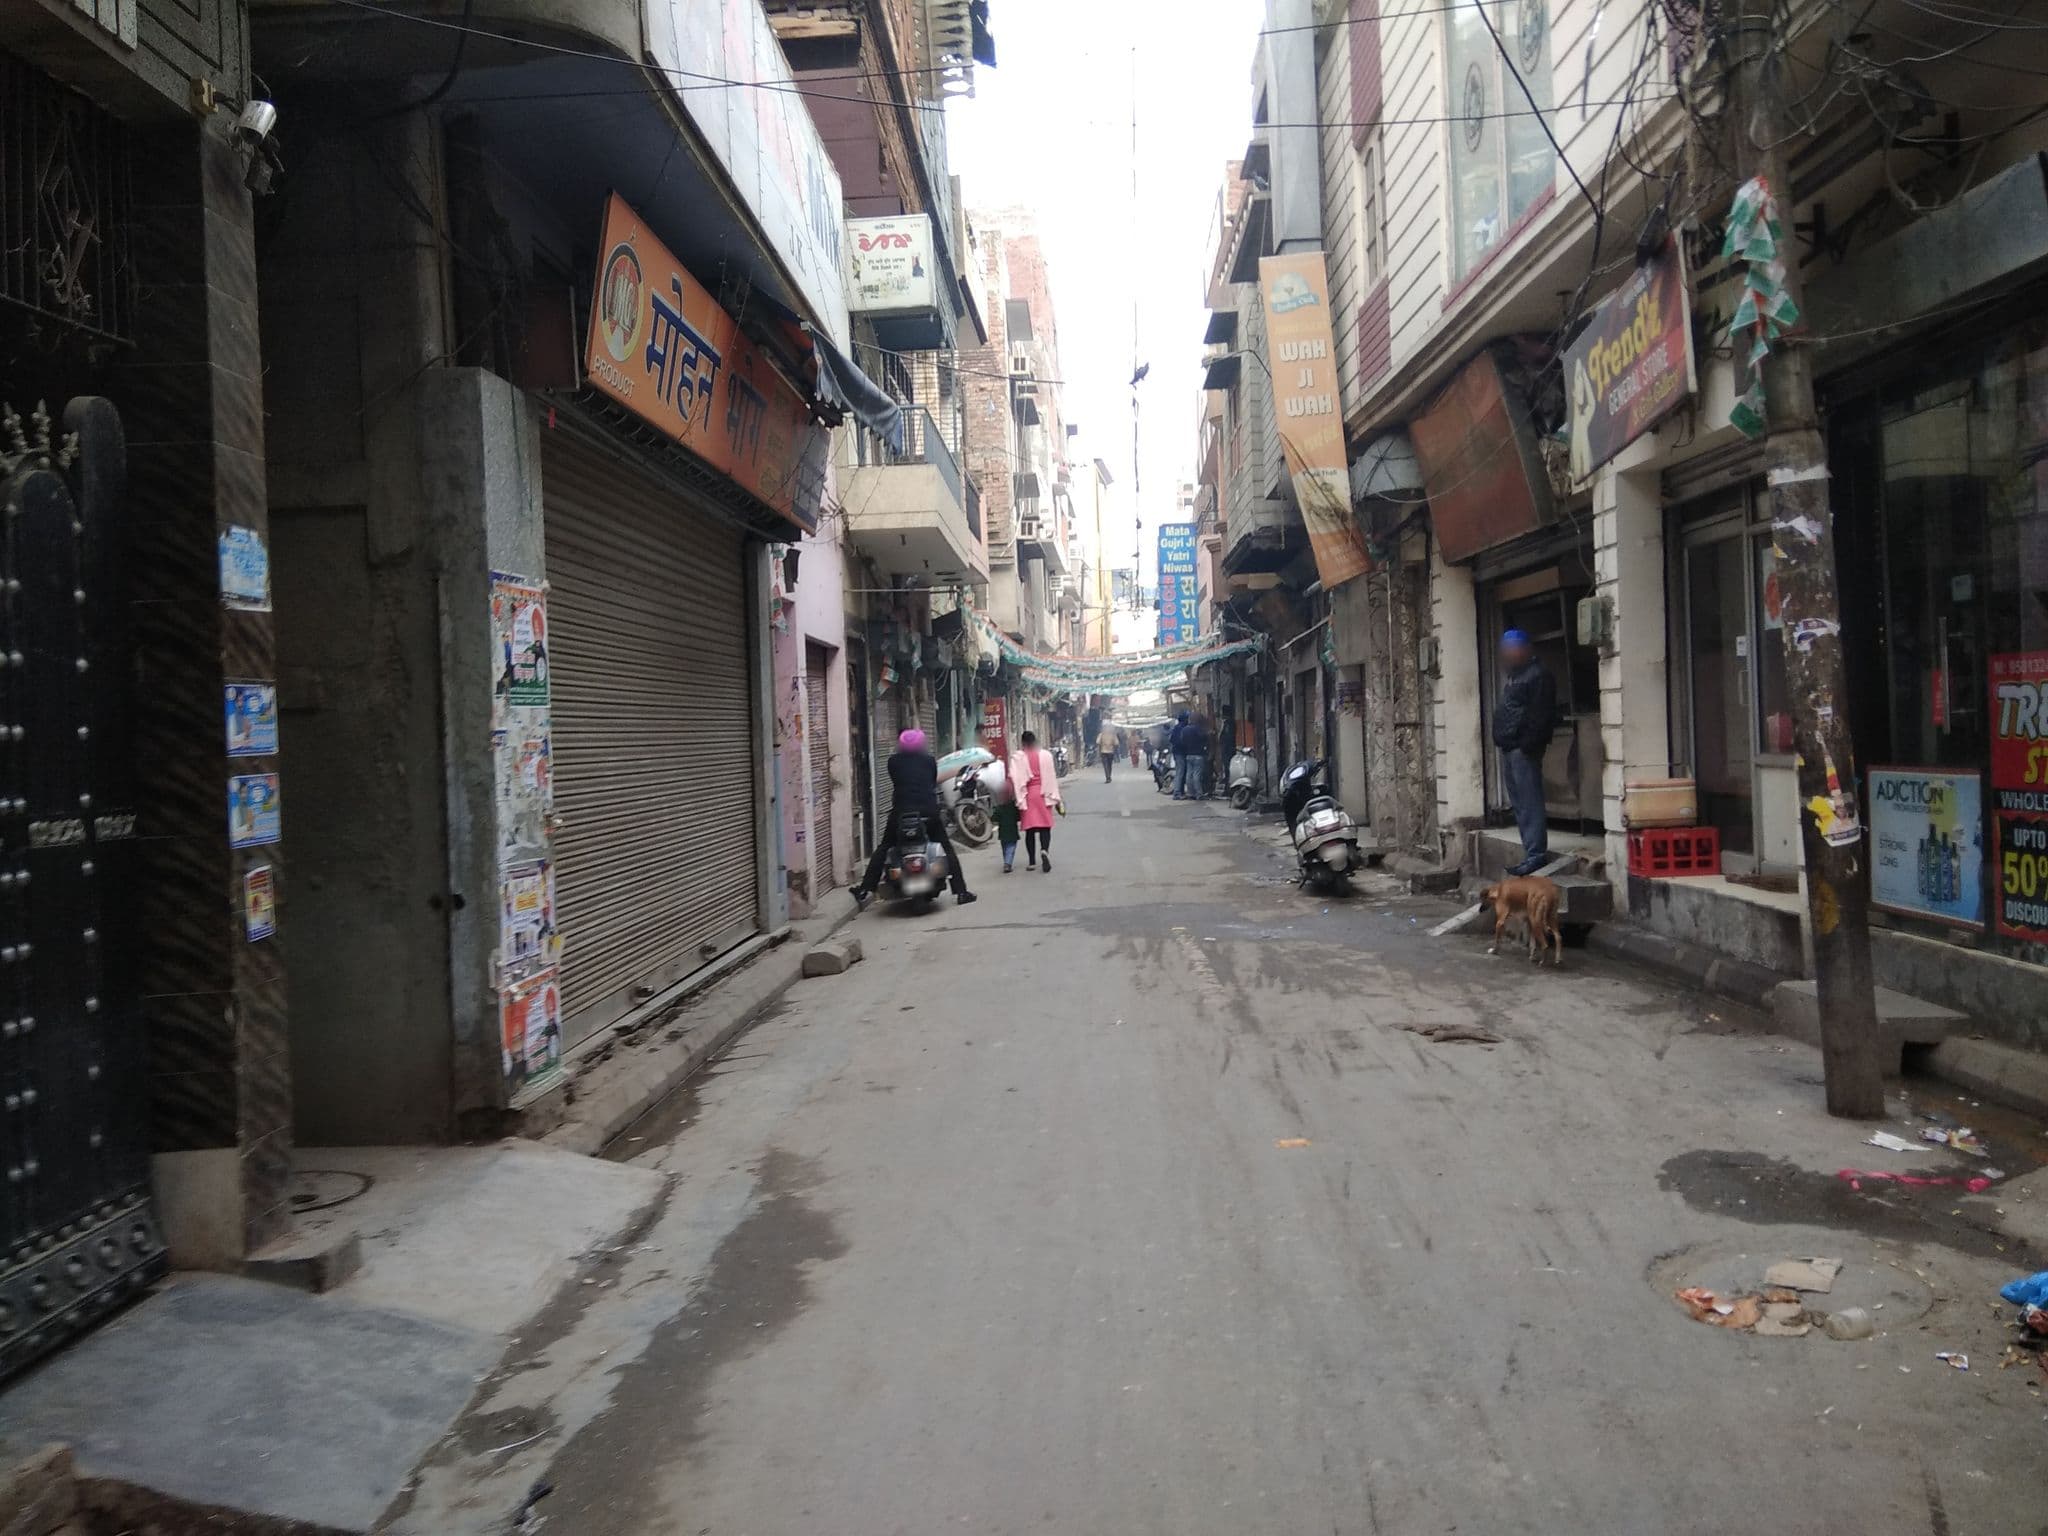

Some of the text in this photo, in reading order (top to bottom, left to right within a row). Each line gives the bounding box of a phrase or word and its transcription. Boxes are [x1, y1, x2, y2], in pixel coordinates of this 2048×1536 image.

[645, 271, 722, 433] मोहन
[1279, 339, 1327, 362] WAH
[594, 355, 635, 398] PRODUCT
[1298, 367, 1314, 389] JI
[1608, 341, 1668, 416] GENERAL STORE
[1285, 393, 1333, 417] WAH
[1165, 526, 1190, 537] Mata
[1160, 537, 1196, 550] Gujri Ji
[1166, 551, 1190, 561] Yatri
[1163, 563, 1194, 574] Niwas
[1181, 575, 1196, 644] सराय
[1876, 780, 1944, 805] ADICTION
[2013, 828, 2047, 850] UPTO
